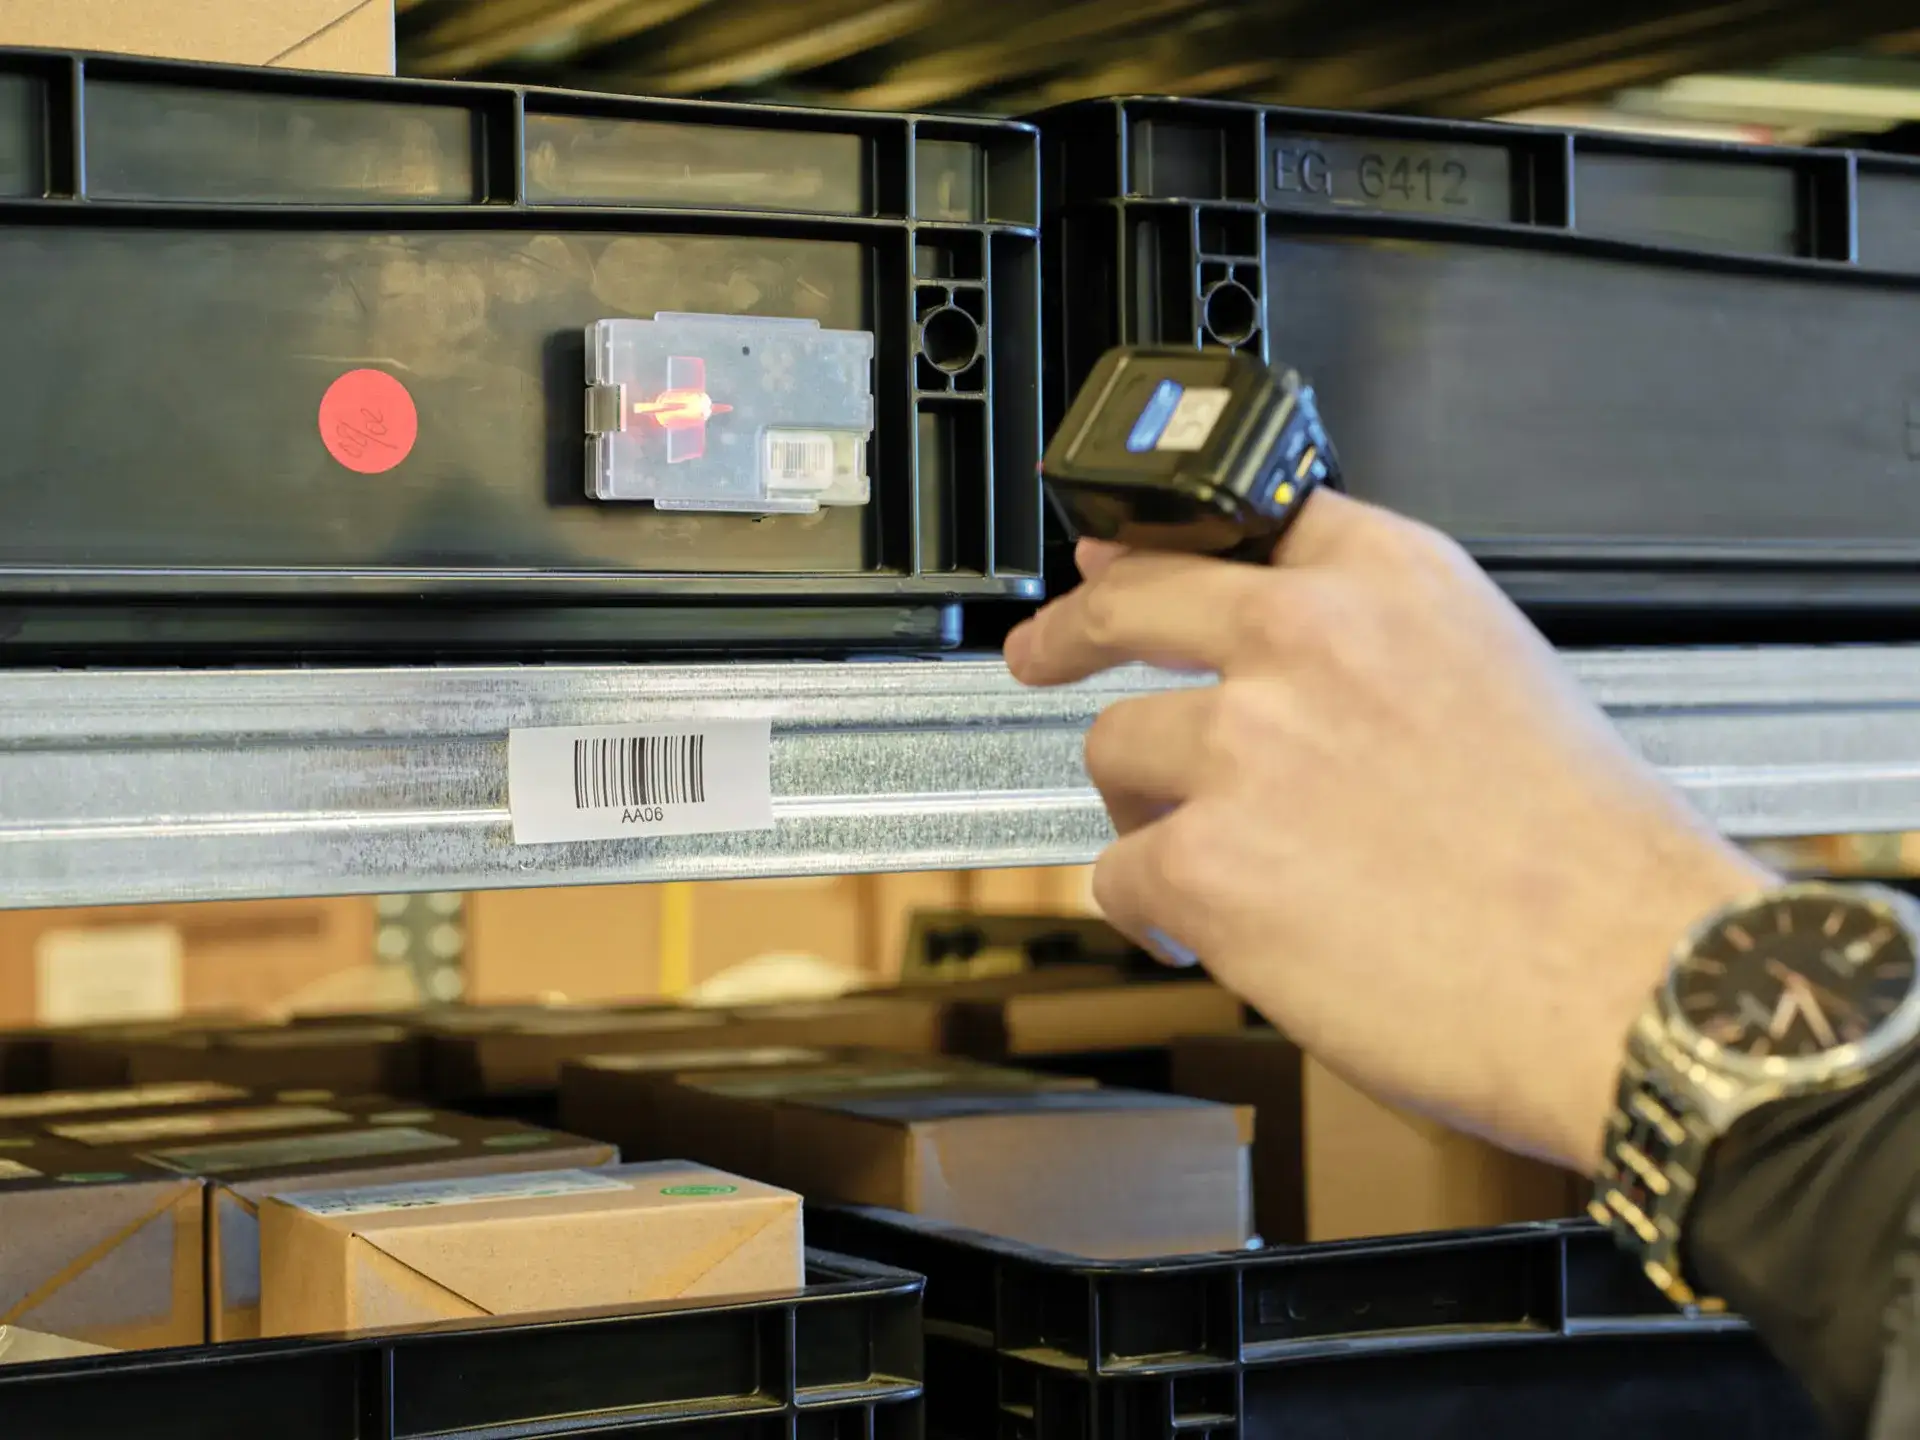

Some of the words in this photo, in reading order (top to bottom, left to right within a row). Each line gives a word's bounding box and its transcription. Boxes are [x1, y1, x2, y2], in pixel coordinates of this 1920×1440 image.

[1274, 149, 1333, 196] EG
[1358, 153, 1468, 205] 6412
[621, 806, 664, 824] AA06
